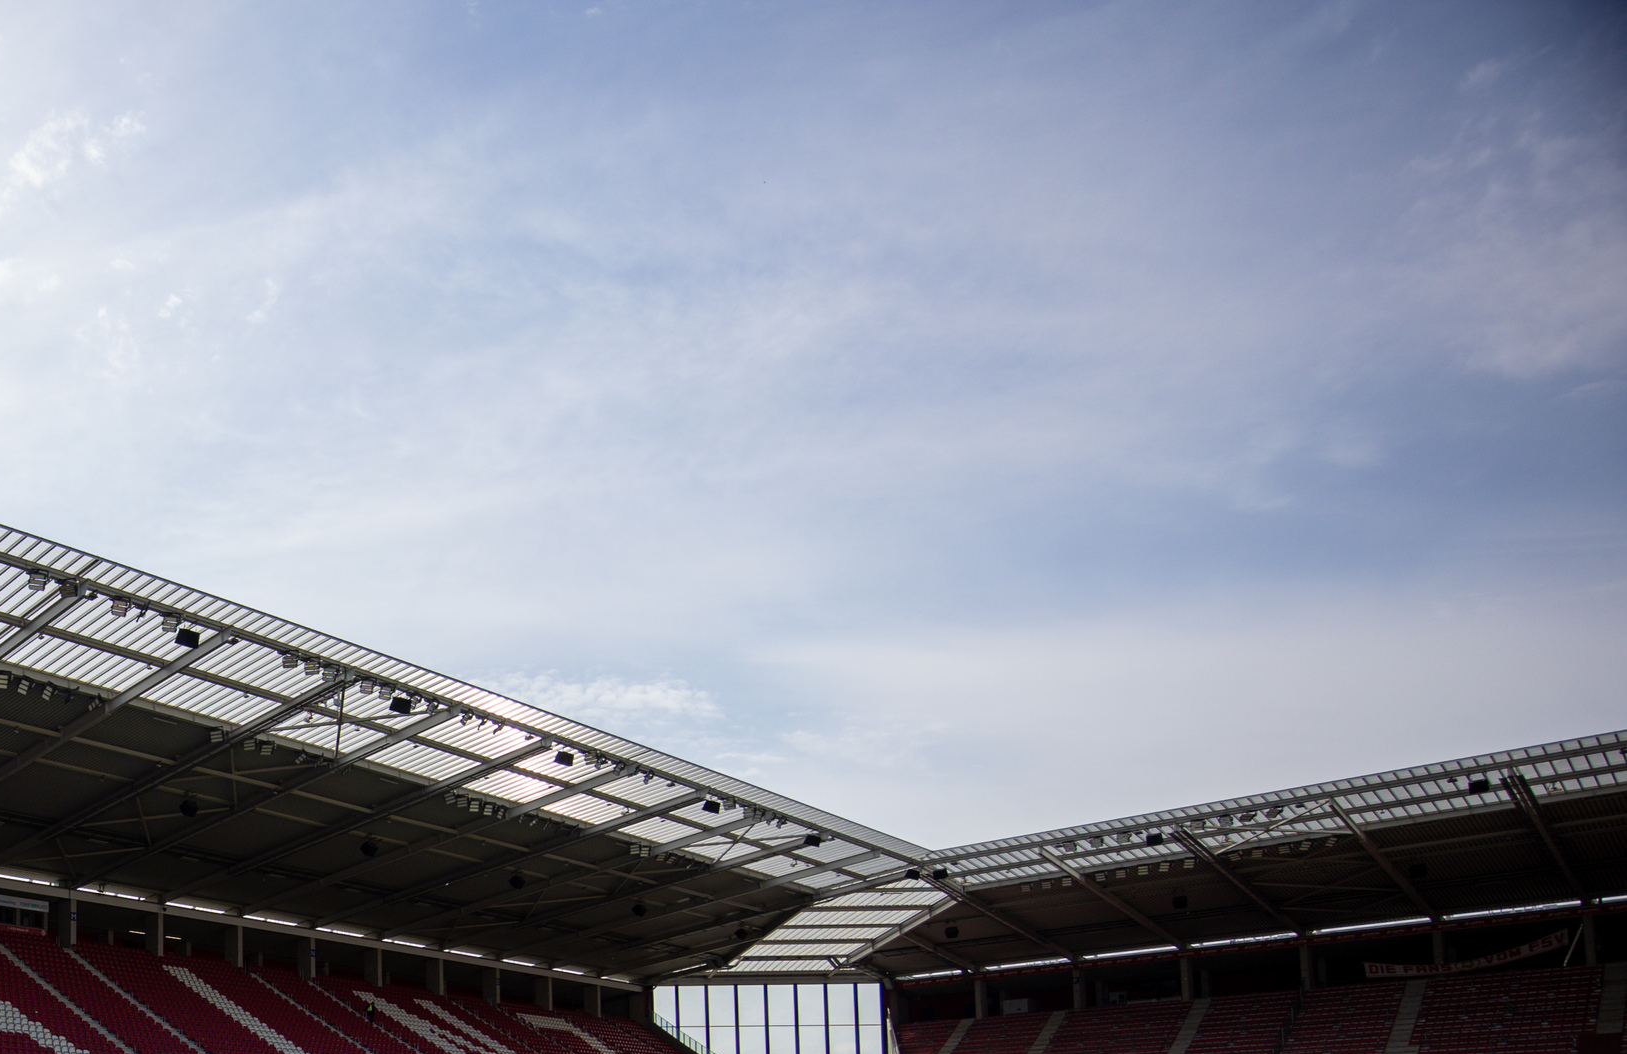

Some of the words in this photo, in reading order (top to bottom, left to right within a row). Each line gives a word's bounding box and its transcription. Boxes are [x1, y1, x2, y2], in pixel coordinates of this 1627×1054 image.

[1369, 964, 1395, 974] DIE
[1484, 948, 1521, 964] VOM
[1529, 931, 1565, 951] FSV
